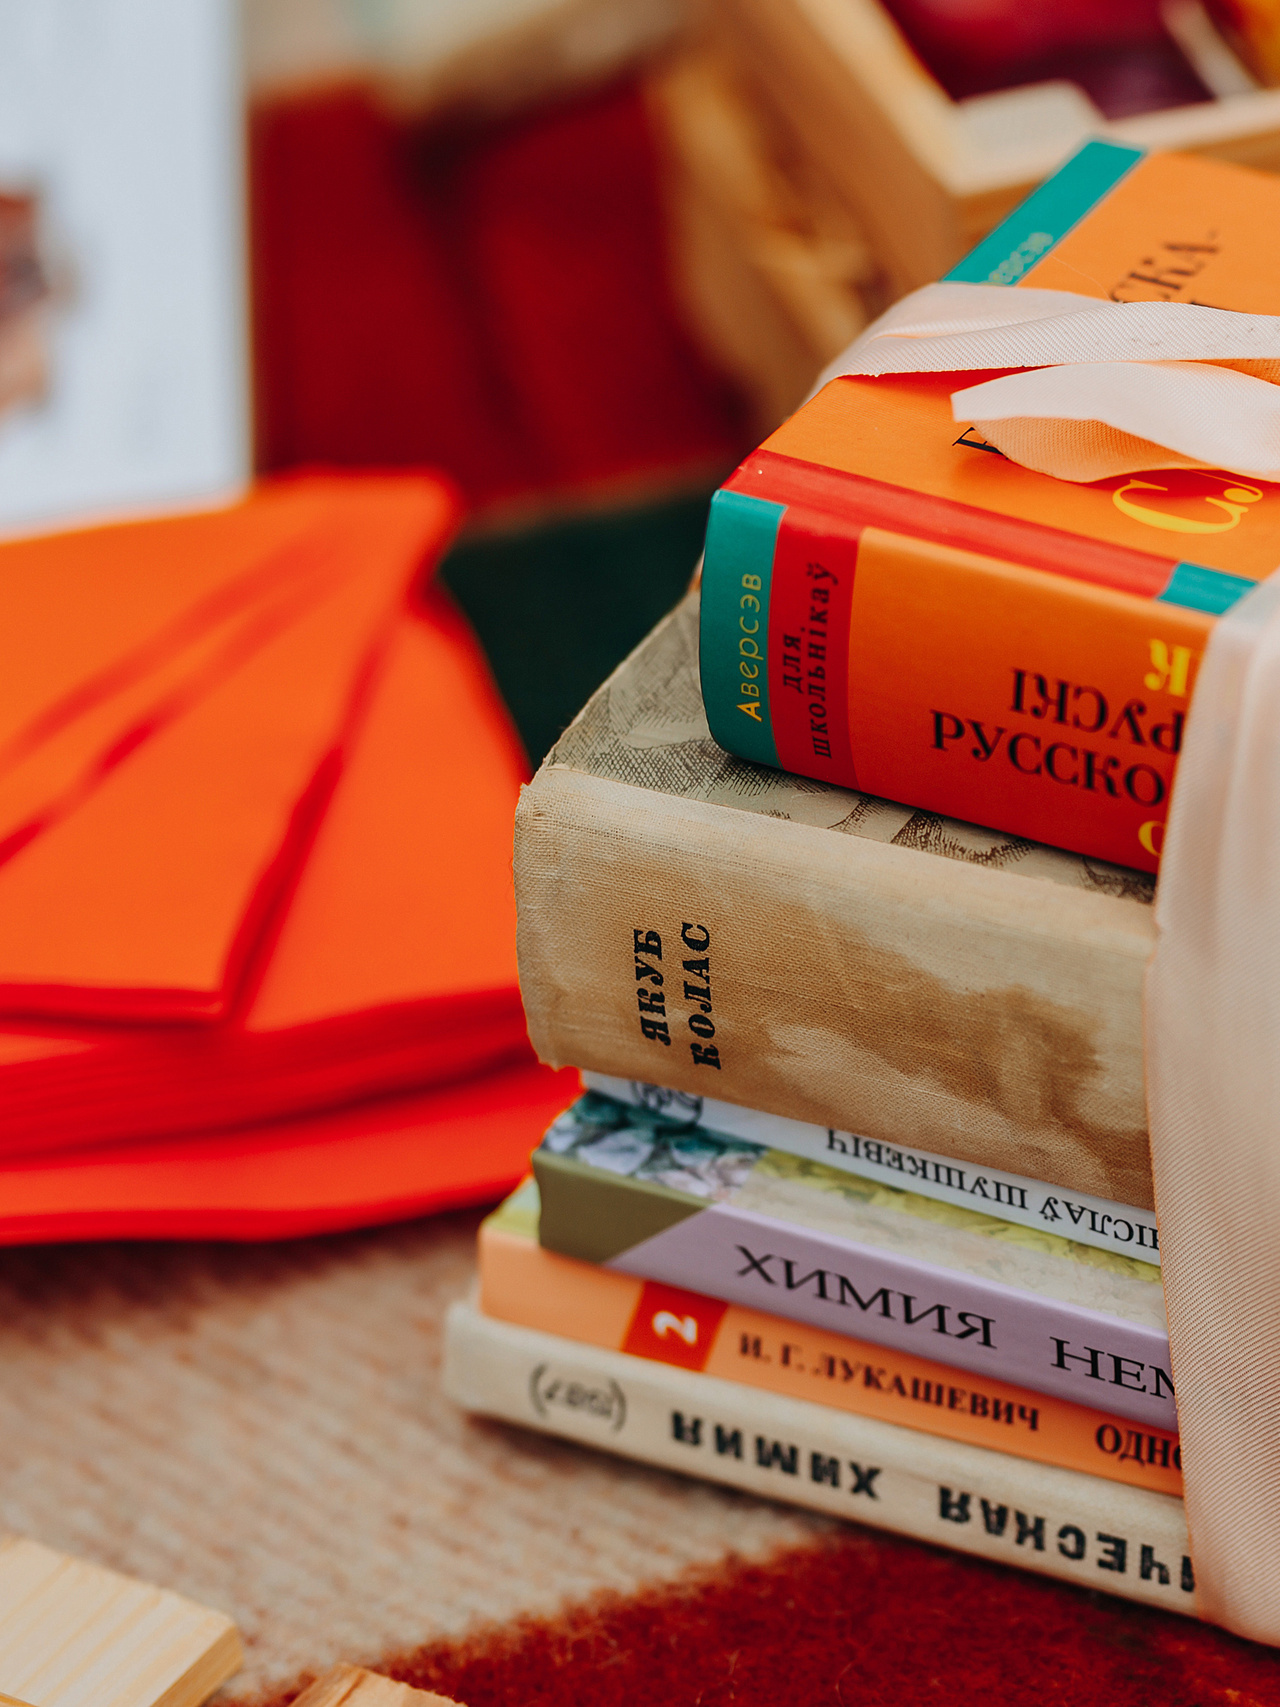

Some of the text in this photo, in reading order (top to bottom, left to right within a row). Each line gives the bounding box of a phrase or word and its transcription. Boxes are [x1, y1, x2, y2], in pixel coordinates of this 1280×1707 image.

[736, 573, 763, 723] Аверсэв
[782, 632, 804, 694] для
[801, 562, 838, 760] школьнікаў
[929, 708, 1166, 808] РУССКО
[633, 927, 672, 1047] ЯКУБ
[680, 921, 722, 1070] КОЛАС
[826, 1127, 1029, 1212] ШУШКЕВІЧ
[652, 1309, 698, 1344] 2
[735, 1244, 999, 1350] ХИМИЯ
[740, 1332, 771, 1362] И.
[779, 1343, 806, 1372] Г.
[811, 1352, 1040, 1433] ЛУКАШЕВИЧ
[670, 1409, 882, 1499] ХИМИЯ
